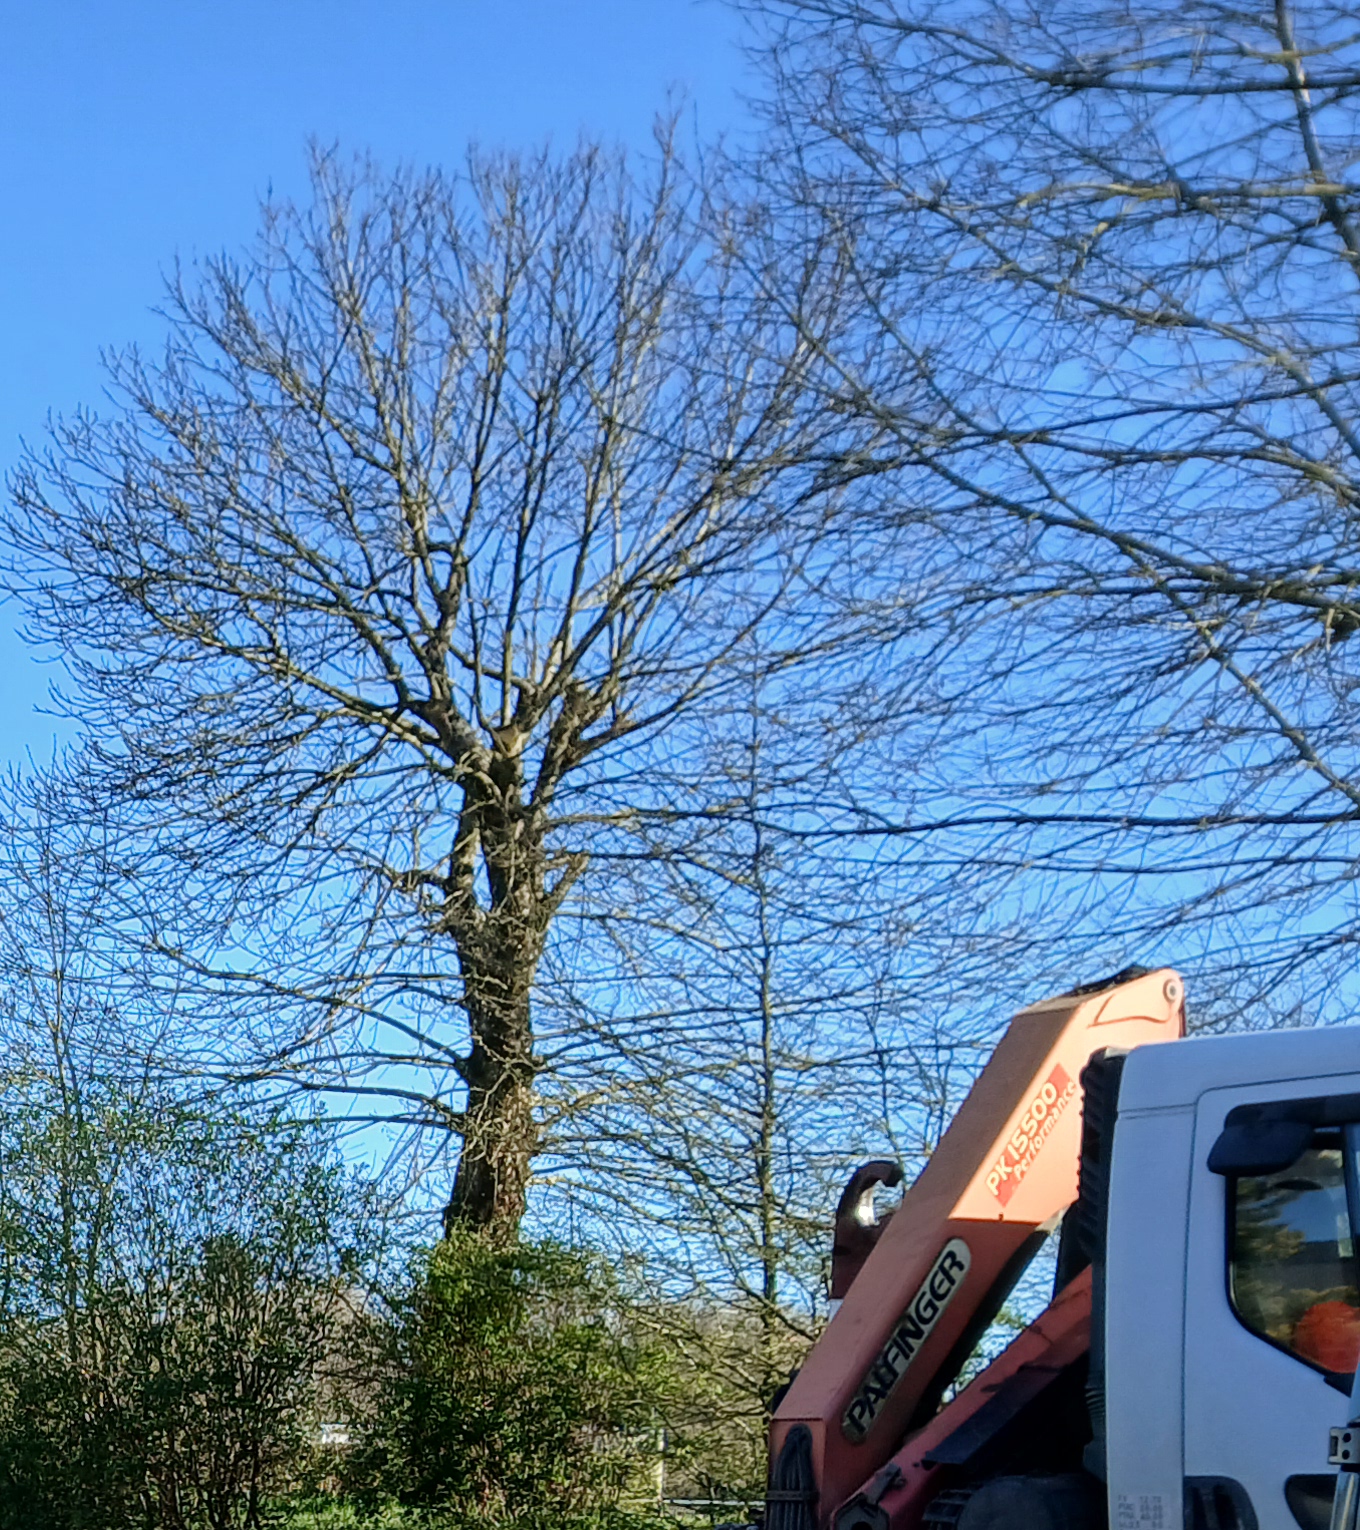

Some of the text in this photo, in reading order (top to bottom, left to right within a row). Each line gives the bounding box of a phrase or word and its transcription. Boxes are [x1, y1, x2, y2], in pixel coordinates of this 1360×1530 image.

[986, 1082, 1057, 1196] PK 15500
[1013, 1081, 1077, 1181] Performance
[847, 1250, 965, 1435] PALFINGER
